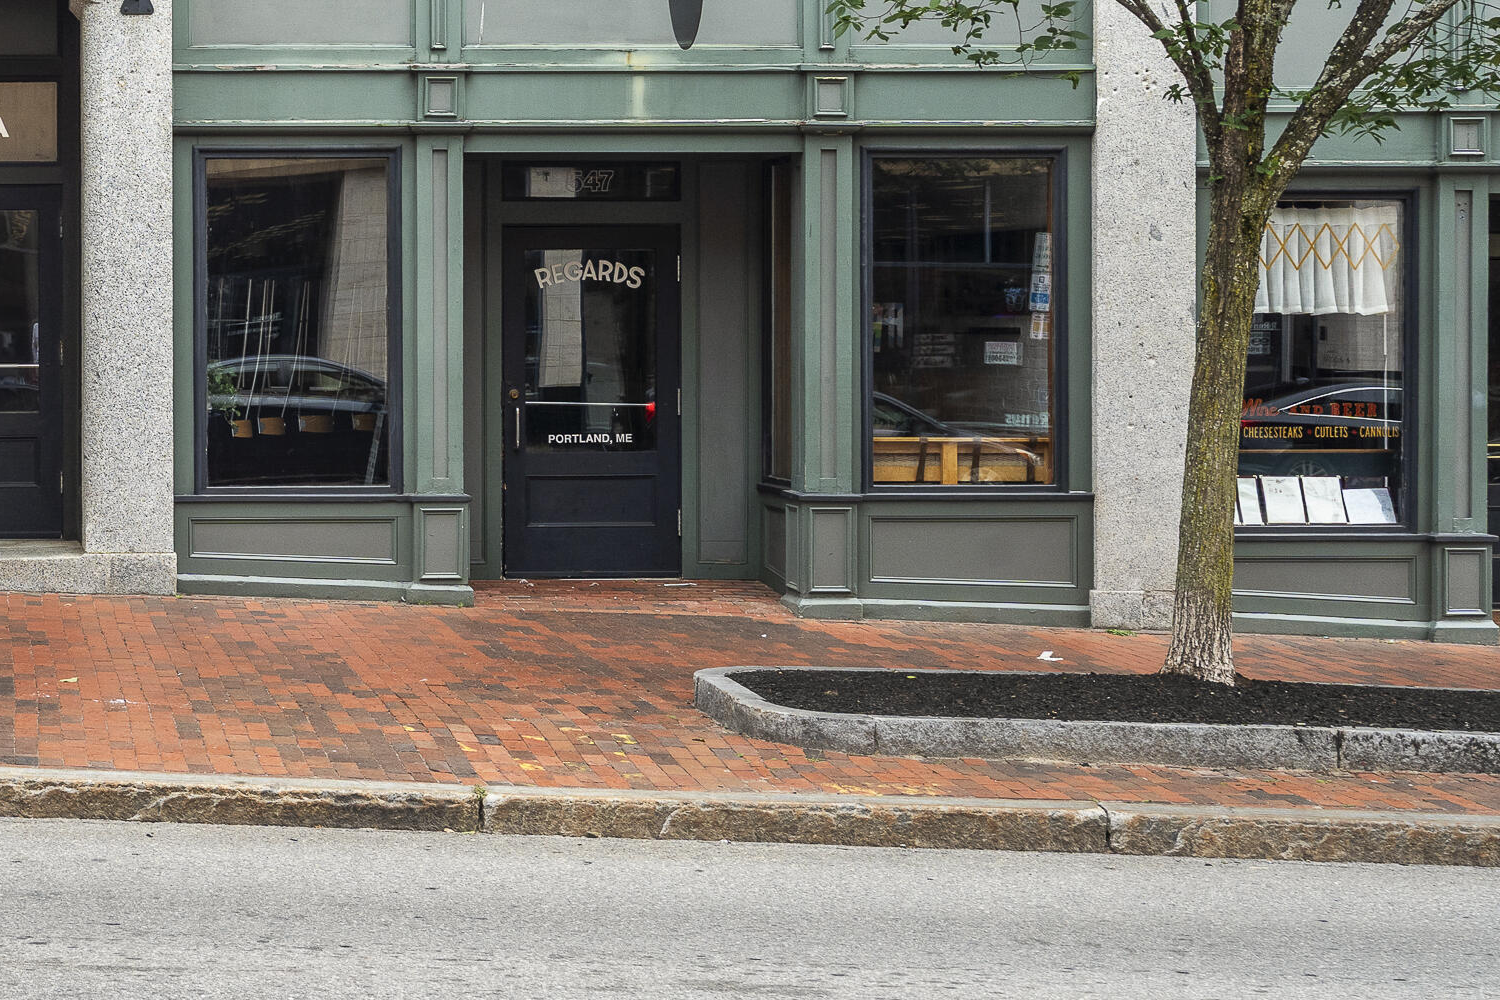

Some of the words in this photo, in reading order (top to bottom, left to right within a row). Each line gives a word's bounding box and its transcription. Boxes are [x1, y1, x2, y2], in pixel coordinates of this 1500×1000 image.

[565, 169, 615, 193] 547
[534, 259, 646, 289] REGARDS
[1240, 397, 1279, 417] Wine
[1330, 402, 1378, 417] BEER
[548, 434, 613, 445] PORTLAND,
[615, 433, 633, 443] ME
[1243, 426, 1303, 438] CHEESESTEAKS
[1314, 426, 1349, 438] CUTLETS
[1359, 426, 1400, 438] CANNOLIS
